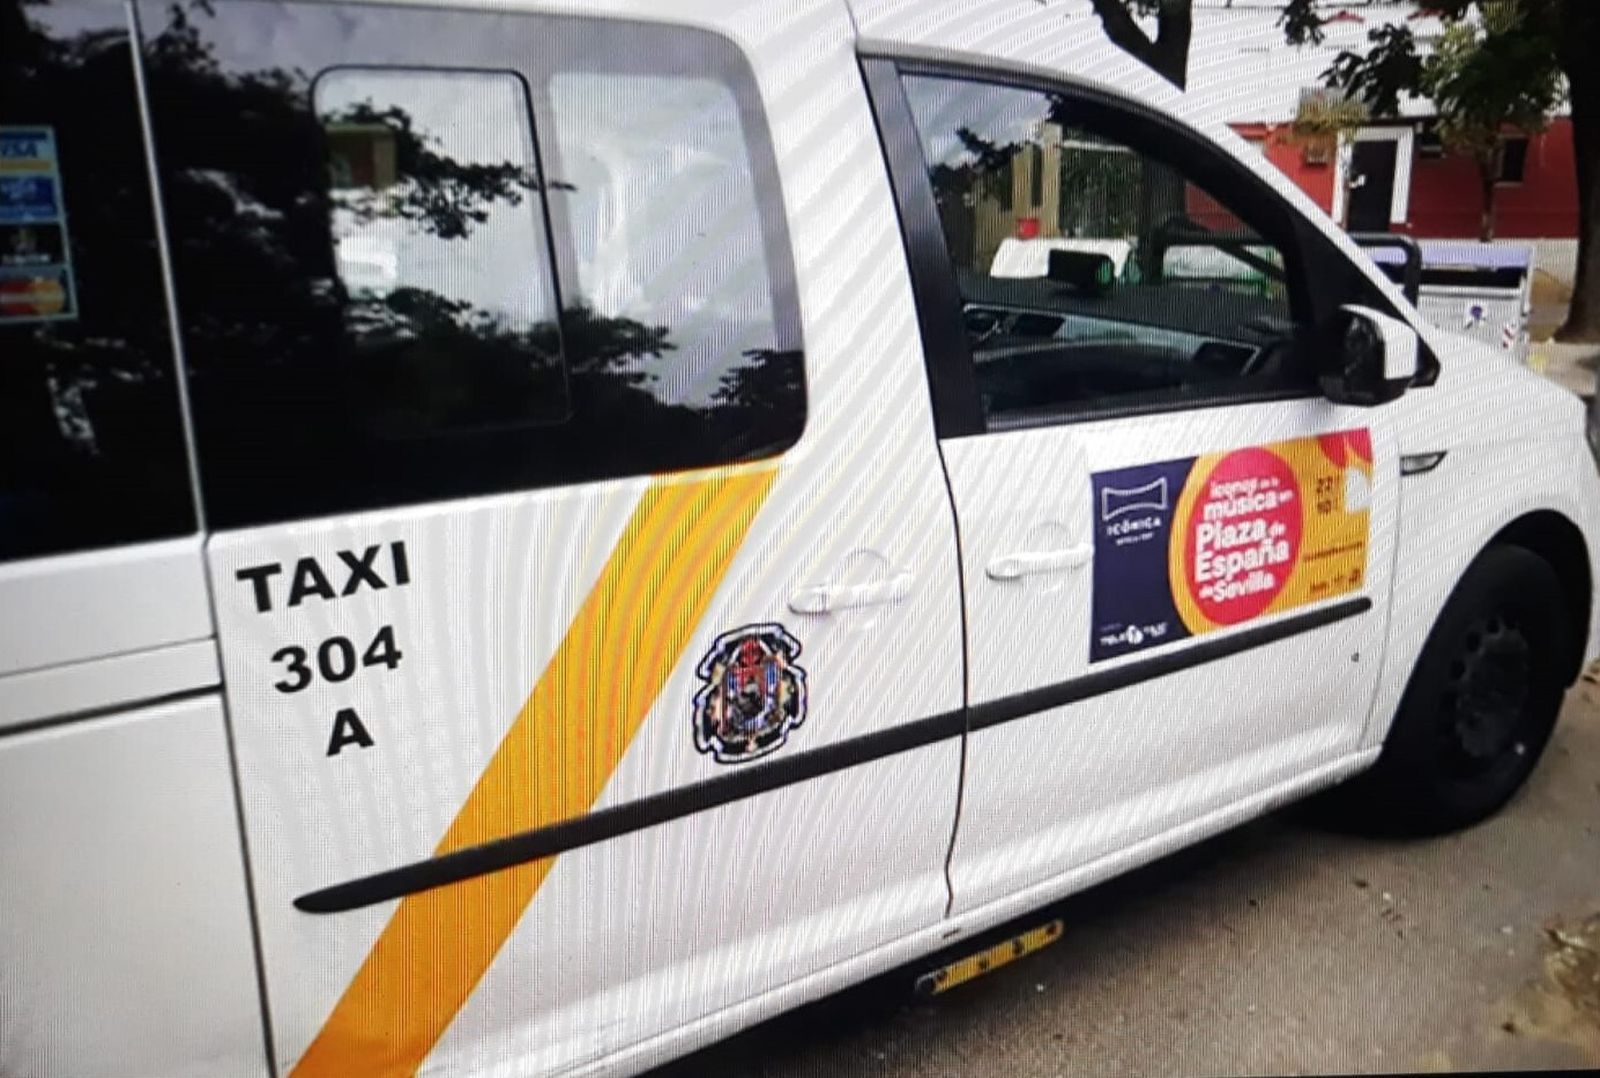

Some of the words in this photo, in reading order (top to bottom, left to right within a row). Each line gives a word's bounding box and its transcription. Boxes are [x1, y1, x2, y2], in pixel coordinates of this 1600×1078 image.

[1196, 517, 1267, 550] Plaza
[235, 540, 410, 613] TAXI
[1195, 537, 1289, 582] España
[1212, 570, 1276, 603] Sevilla
[271, 625, 403, 694] 304
[326, 707, 375, 758] A
